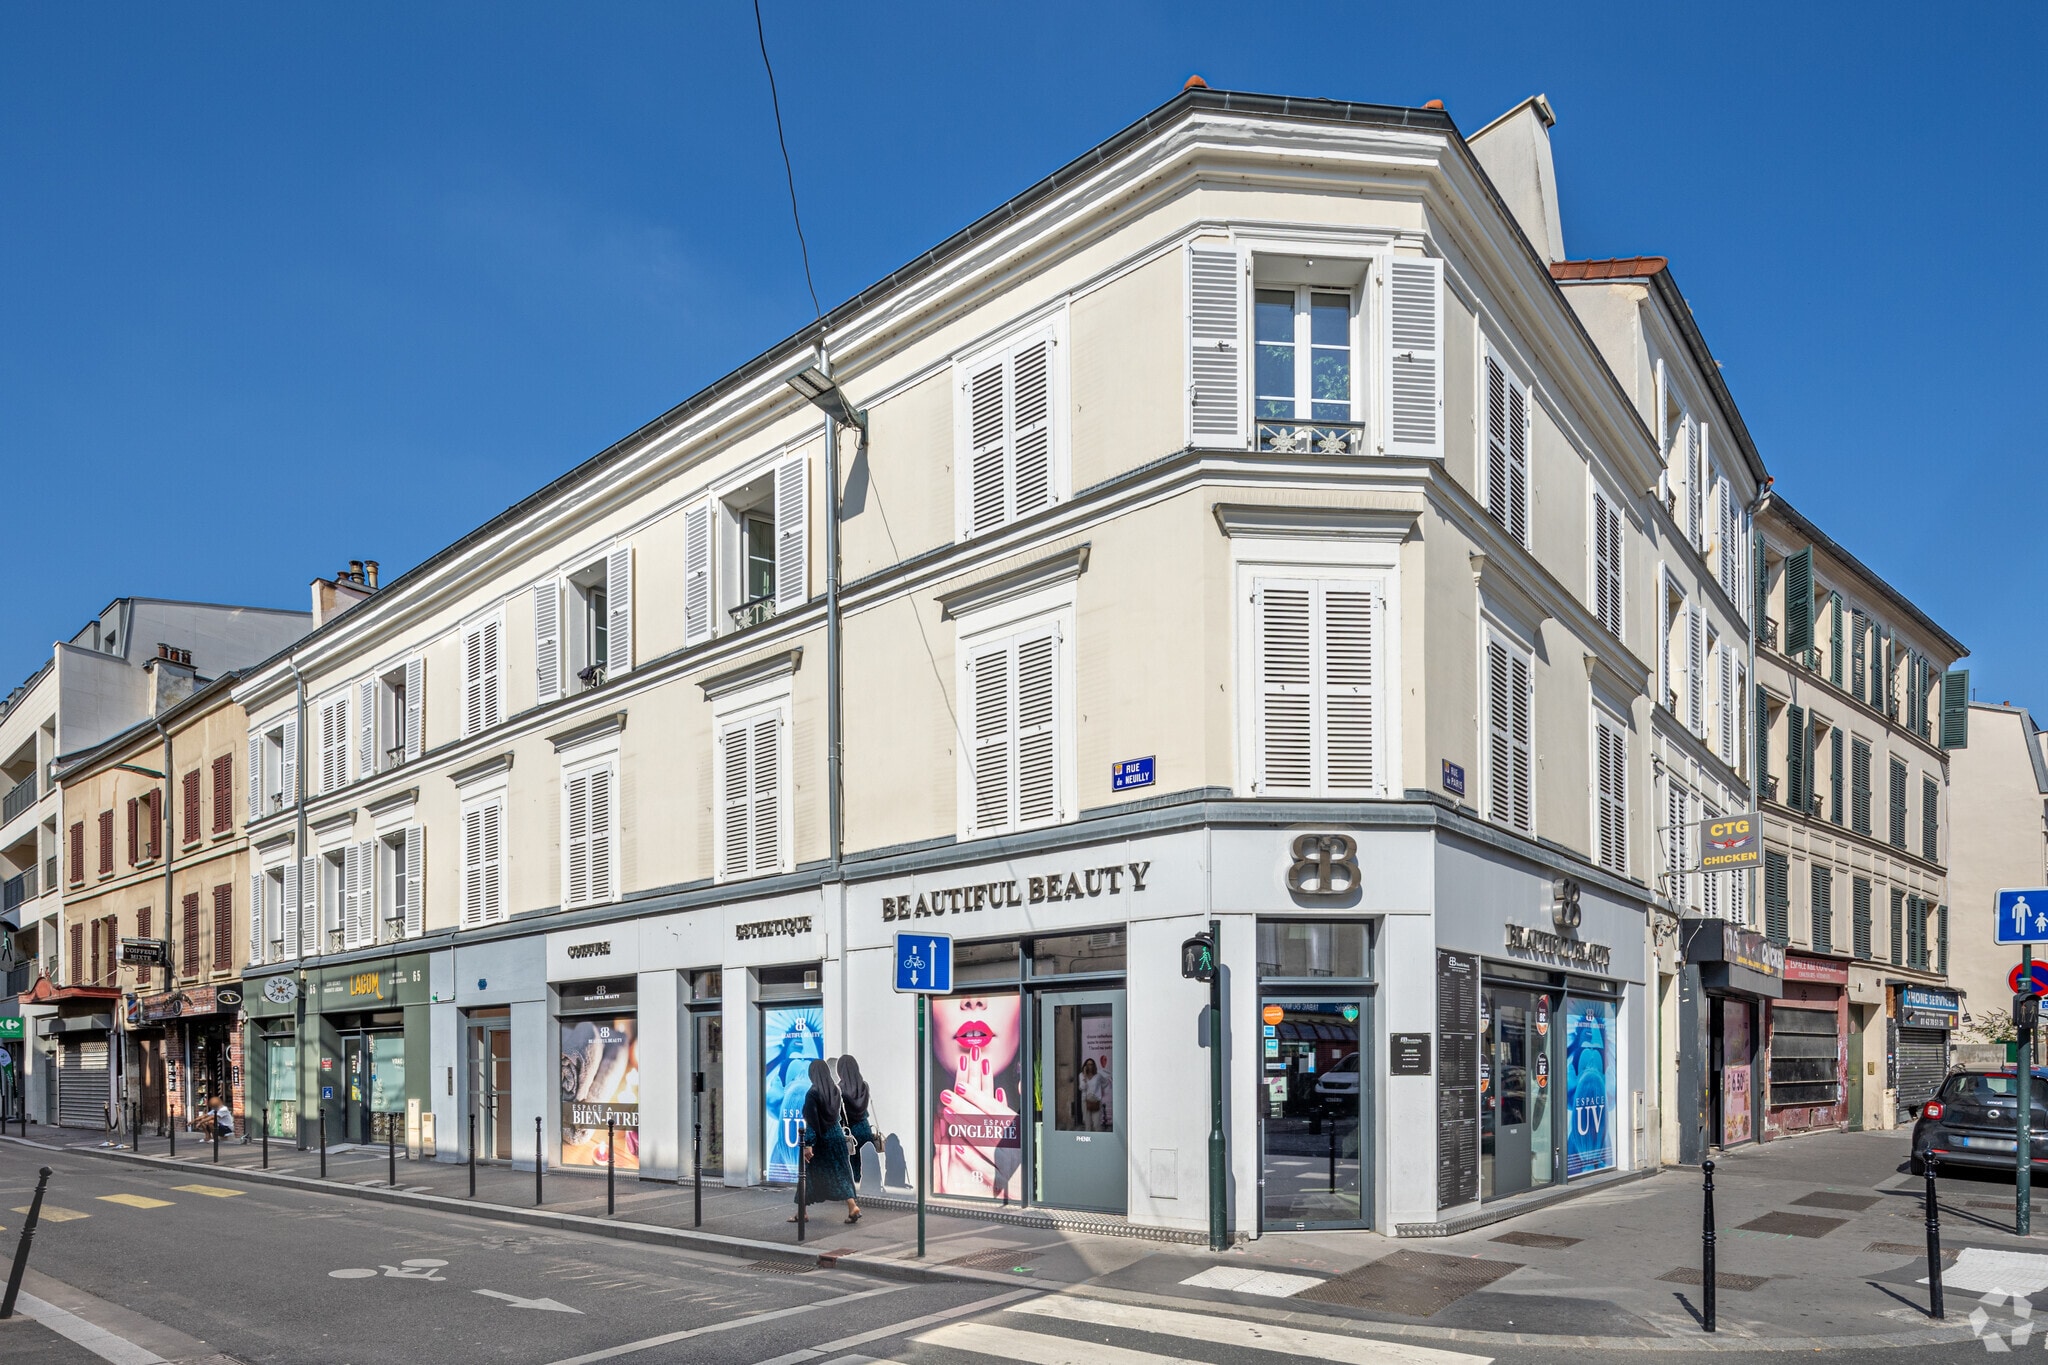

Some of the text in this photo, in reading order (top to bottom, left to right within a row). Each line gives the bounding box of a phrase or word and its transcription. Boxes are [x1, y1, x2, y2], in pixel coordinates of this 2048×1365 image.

[1126, 763, 1140, 773] RUE
[1116, 772, 1149, 786] de NEUILLY
[1710, 820, 1749, 837] CTG
[1703, 852, 1757, 866] CHICKEN
[882, 861, 1151, 922] BEAUTIFUL BEAUTY
[125, 947, 158, 956] COIFFEUR
[412, 970, 421, 982] 65
[350, 971, 384, 1000] LAGOM
[1907, 991, 1929, 1005] PHONE
[572, 1104, 603, 1112] ESPACE
[1575, 1096, 1605, 1107] ESPACE
[573, 1106, 640, 1127] BIEN-ÊTRE
[983, 1119, 1017, 1127] ESPACE
[1575, 1104, 1605, 1136] UV
[948, 1124, 1017, 1140] ONGLERIE
